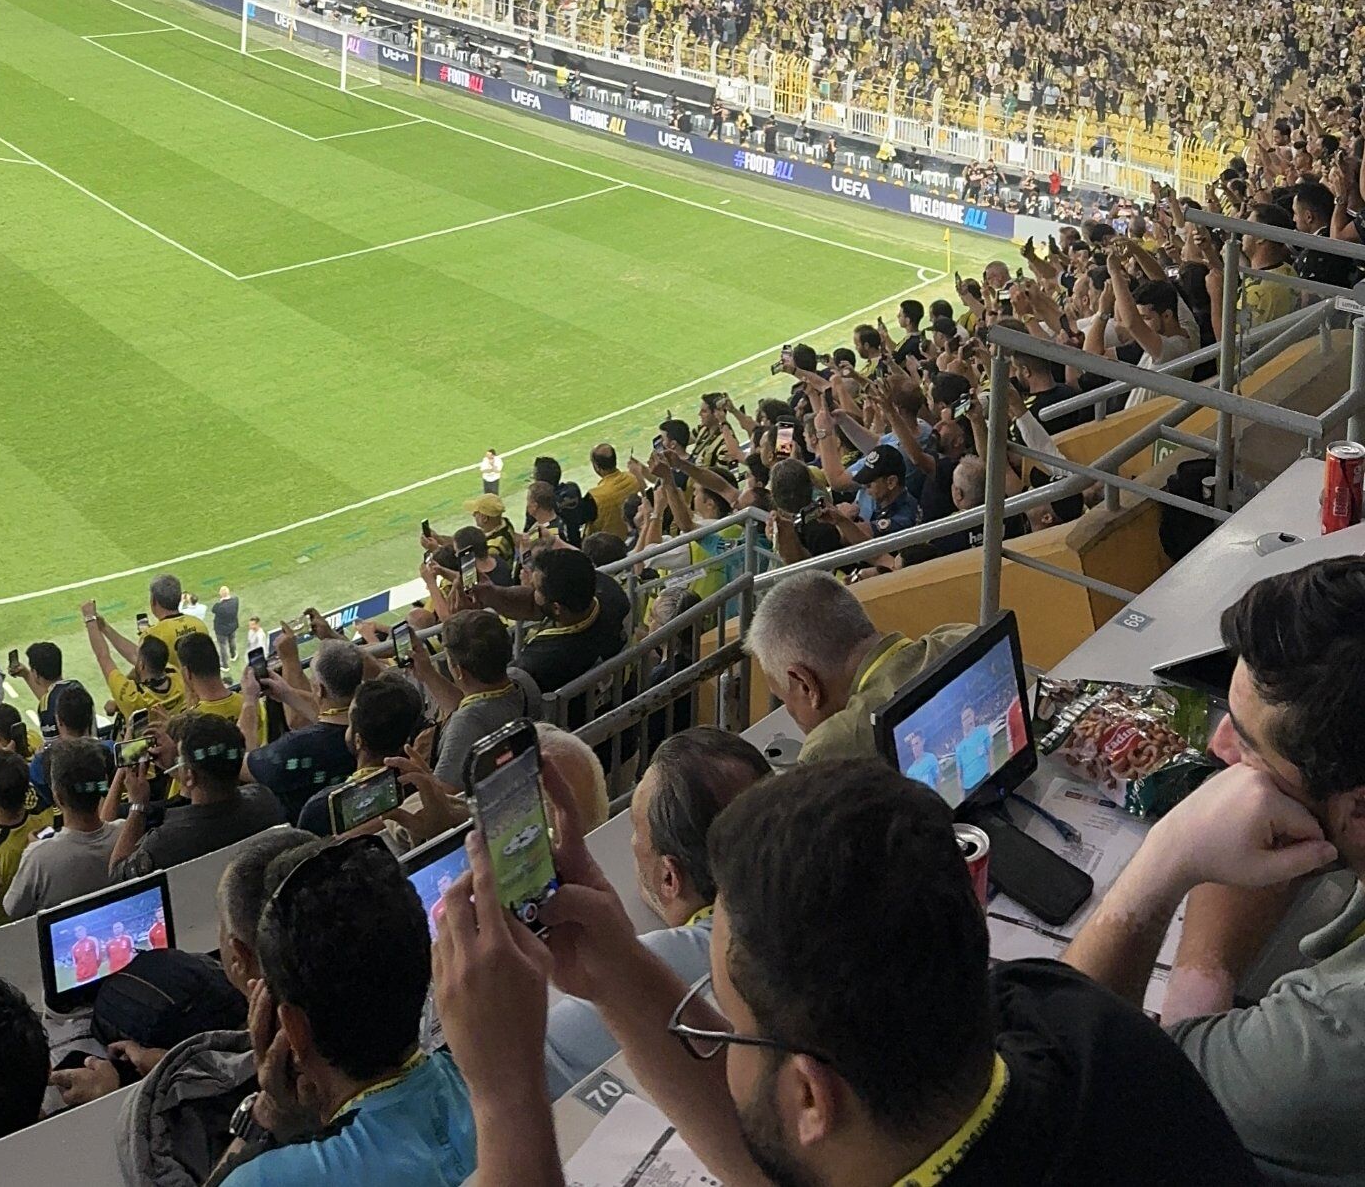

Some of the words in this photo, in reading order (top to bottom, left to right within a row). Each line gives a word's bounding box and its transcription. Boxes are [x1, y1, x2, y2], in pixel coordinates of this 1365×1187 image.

[274, 12, 297, 32] UEFA
[440, 64, 483, 94] #FOOTBALL
[511, 88, 542, 110] UEFA
[658, 130, 693, 154] UEFA
[734, 151, 794, 181] #FOOTBALL
[831, 175, 871, 200] UEFA
[1124, 615, 1145, 627] 68
[585, 1080, 623, 1108] 70
